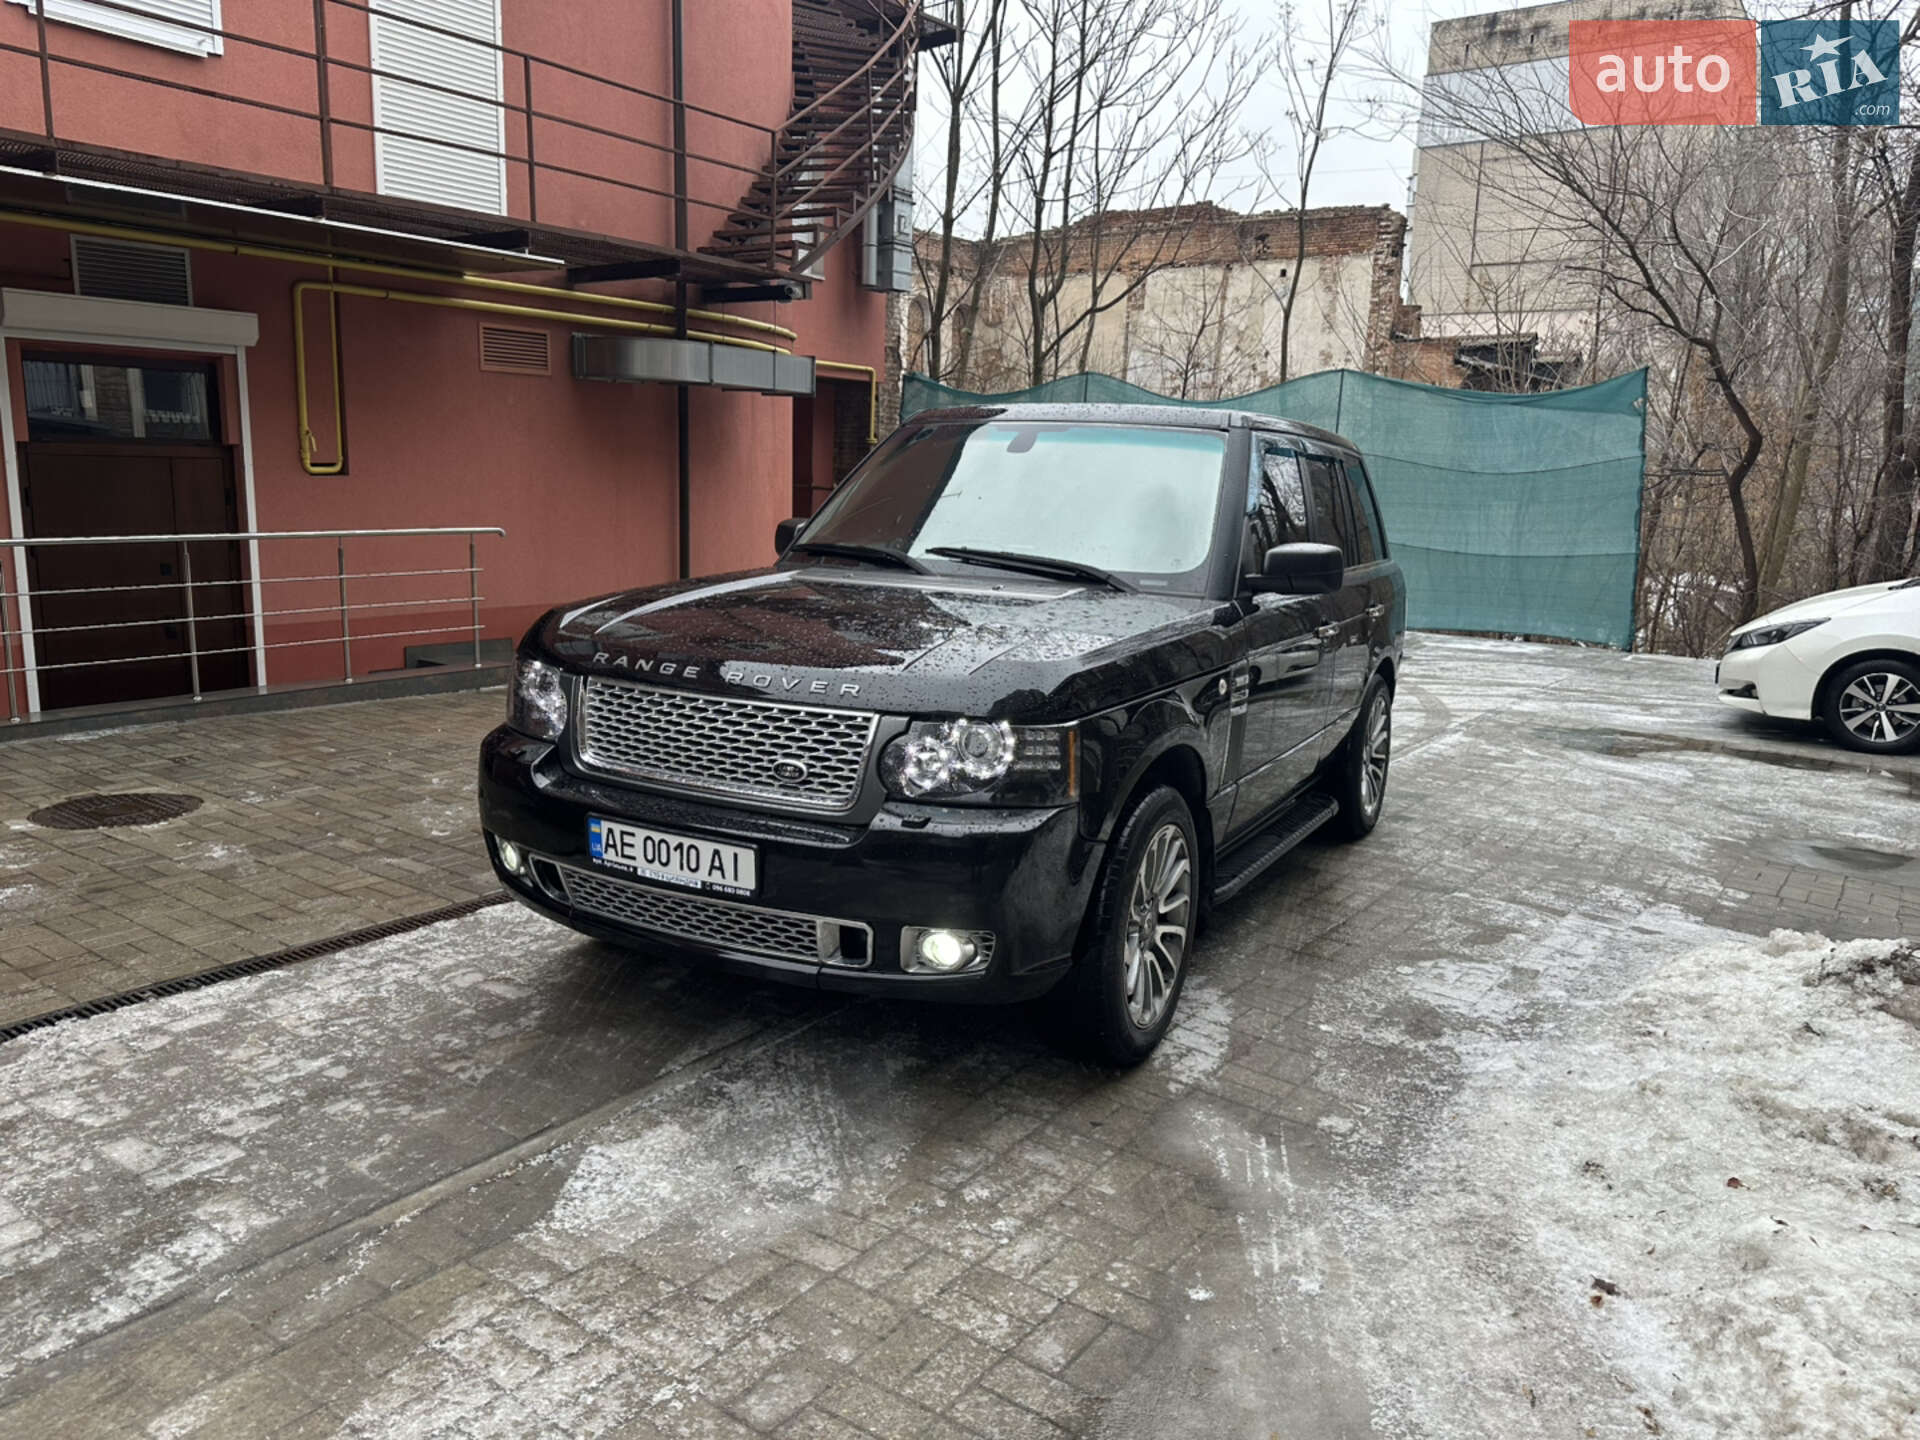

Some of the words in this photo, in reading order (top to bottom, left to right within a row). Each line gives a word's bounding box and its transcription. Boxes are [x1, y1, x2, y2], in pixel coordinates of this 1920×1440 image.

[592, 652, 700, 678] RANGE
[725, 671, 862, 697] ROVER
[604, 827, 637, 861] AE
[643, 835, 700, 873] 0010
[708, 848, 738, 882] AI
